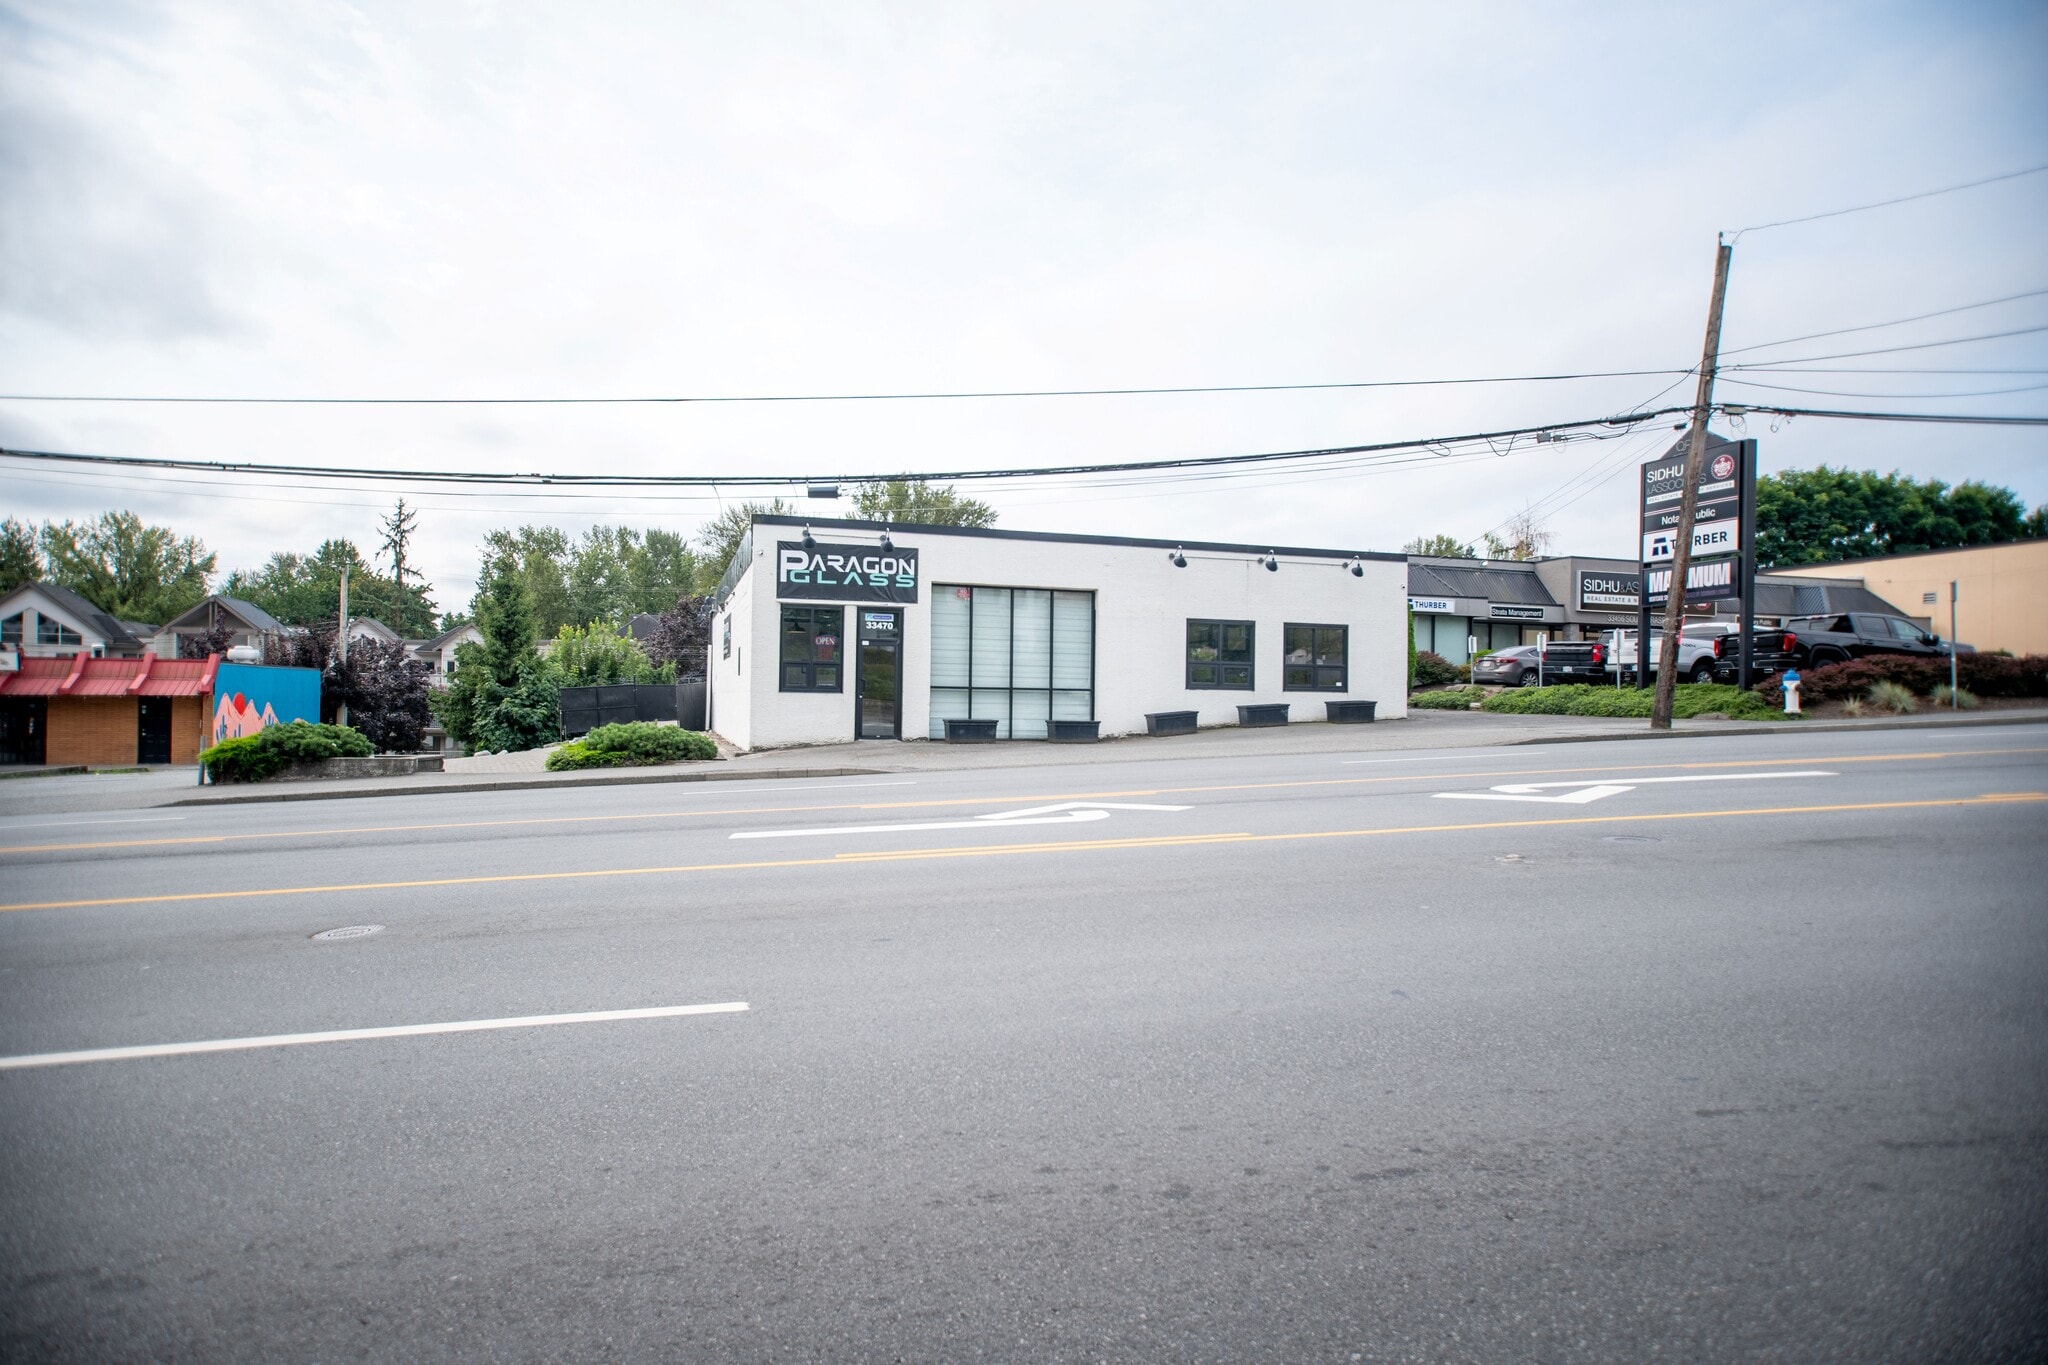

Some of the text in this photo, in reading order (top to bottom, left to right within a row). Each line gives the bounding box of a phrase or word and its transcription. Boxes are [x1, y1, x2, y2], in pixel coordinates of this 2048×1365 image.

[1647, 464, 1684, 483] SIDHU
[1670, 531, 1728, 549] TRBER
[780, 549, 915, 582] PARAGON
[789, 569, 915, 588] GLASS
[1648, 562, 1731, 593] MAMUM
[1583, 579, 1620, 593] SIDHU
[1415, 601, 1447, 609] THURBER
[1491, 607, 1543, 618] Strata Management
[865, 621, 894, 630] 33470
[815, 636, 835, 645] OPEN
